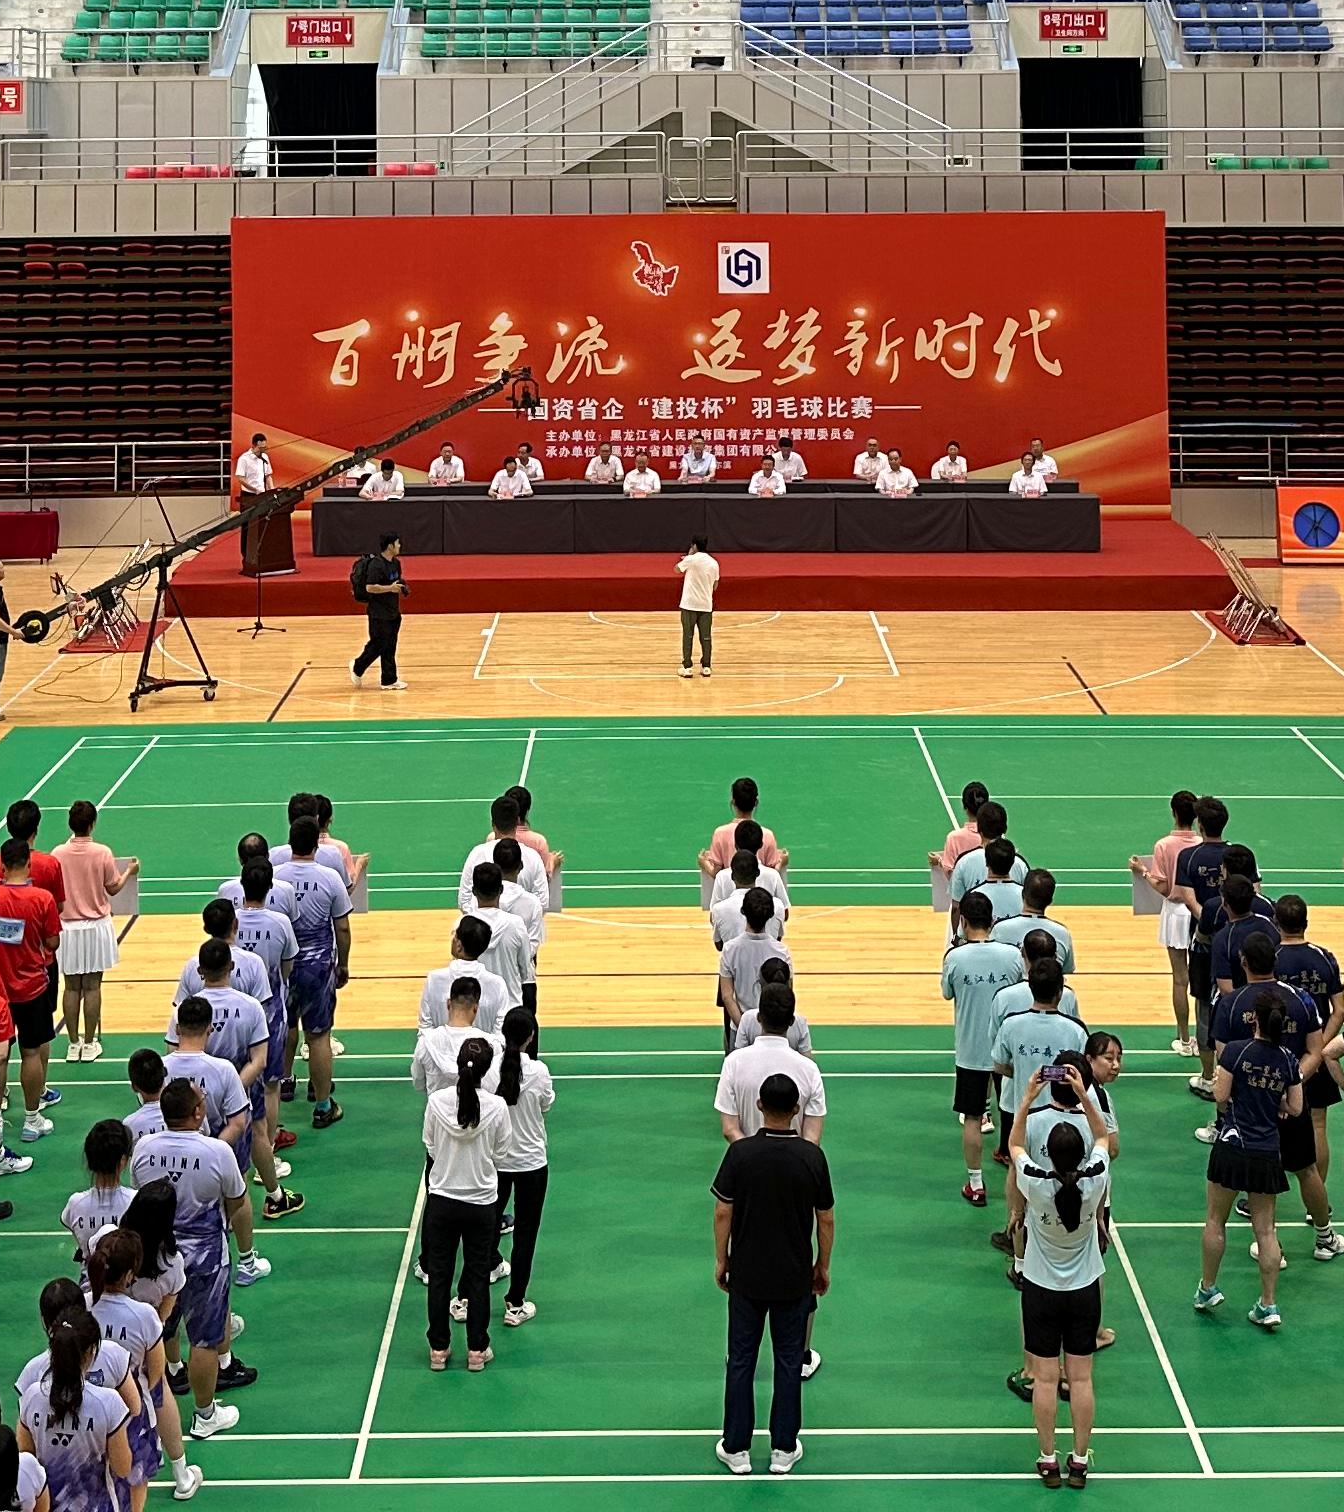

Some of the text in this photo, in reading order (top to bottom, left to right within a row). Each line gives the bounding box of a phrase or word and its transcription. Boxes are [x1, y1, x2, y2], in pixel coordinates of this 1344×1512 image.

[290, 19, 342, 34] 7号门出口
[1043, 13, 1095, 27] 8号门出口
[312, 306, 1063, 388] 百舸争流 逐梦新时代
[238, 930, 271, 940] HINA
[149, 1155, 200, 1170] CHINA
[78, 1214, 119, 1229] CHIN
